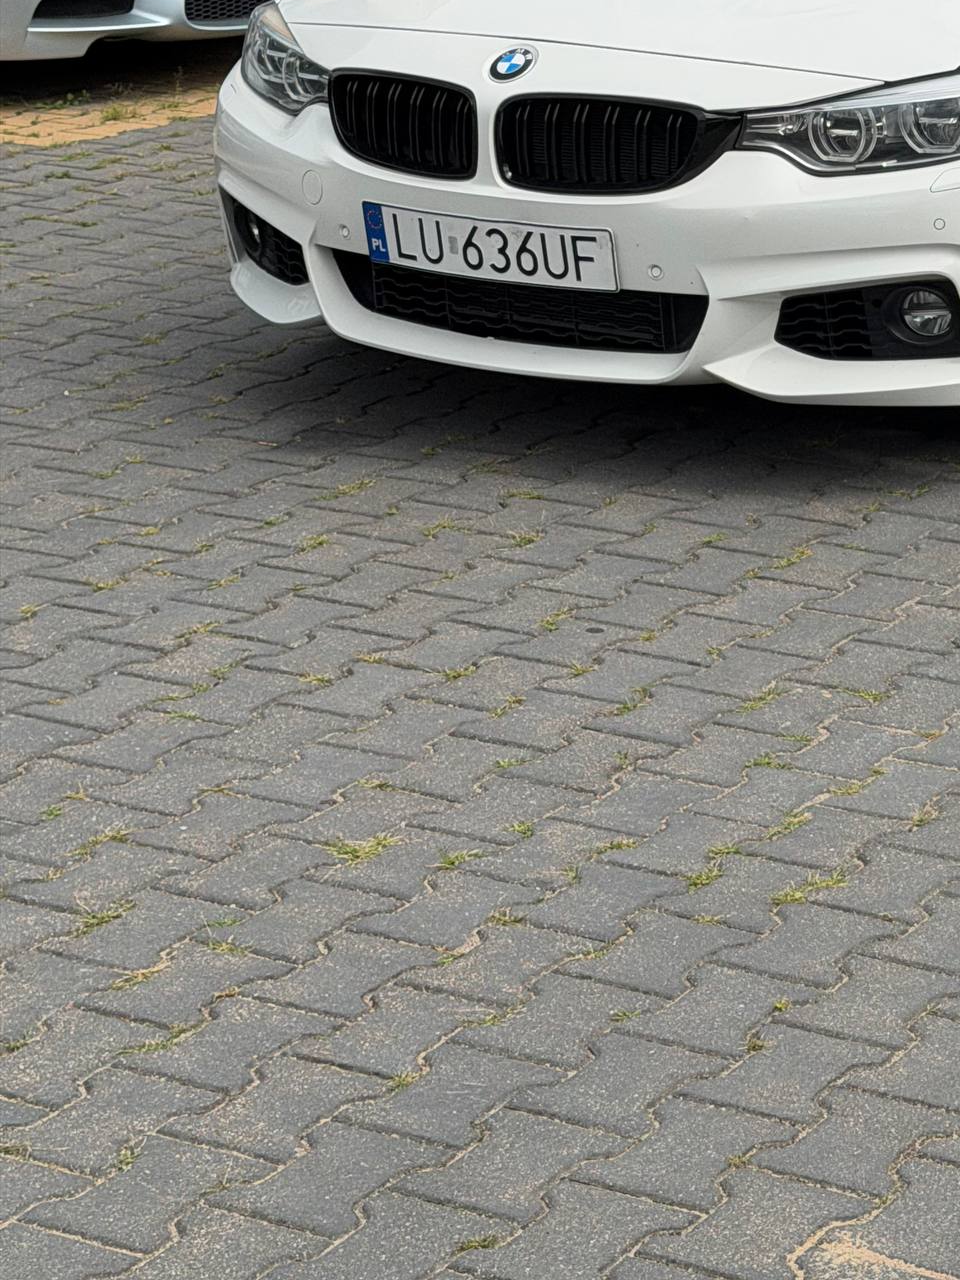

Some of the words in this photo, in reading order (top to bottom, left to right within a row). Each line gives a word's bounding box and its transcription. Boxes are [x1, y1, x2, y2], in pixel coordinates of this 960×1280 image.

[371, 238, 386, 252] PL
[392, 213, 444, 265] LU
[462, 225, 598, 283] 636UF
